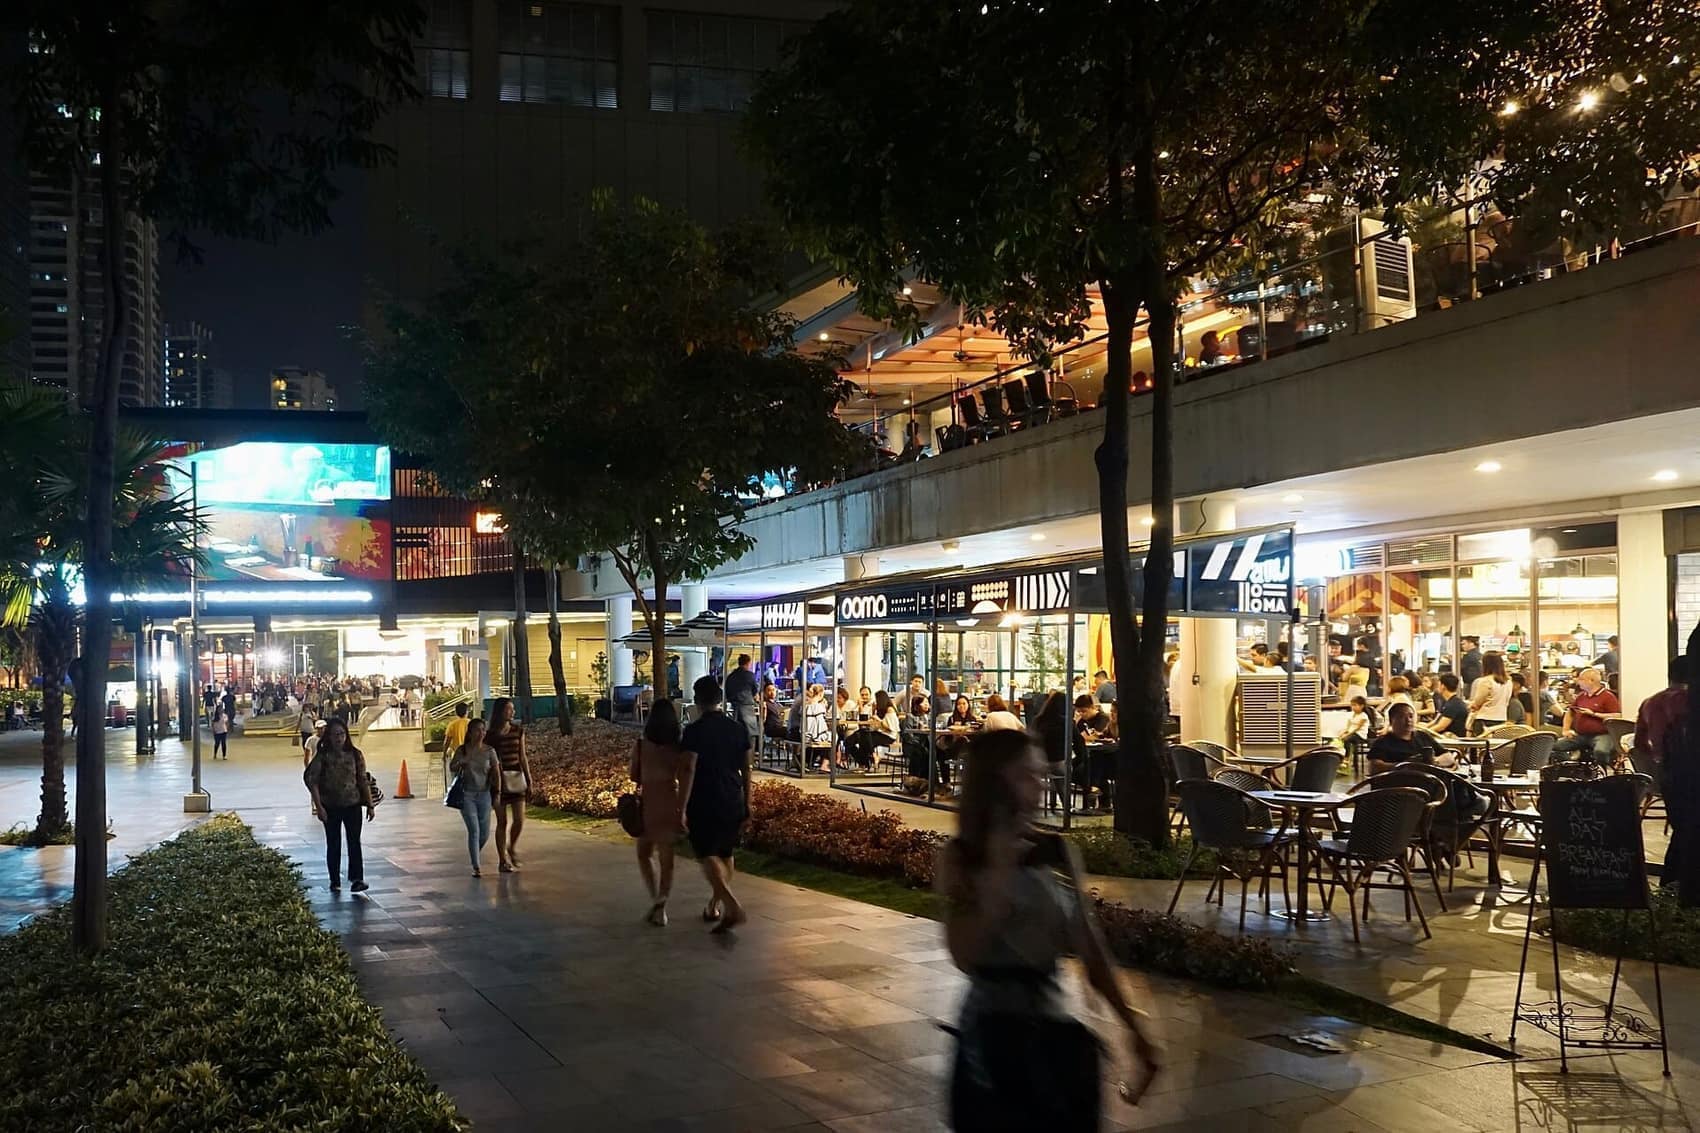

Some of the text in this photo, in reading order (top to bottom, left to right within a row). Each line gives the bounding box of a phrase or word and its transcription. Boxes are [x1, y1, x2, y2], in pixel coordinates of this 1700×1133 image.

[1568, 807, 1607, 824] ALL
[1569, 823, 1607, 845] DAY
[1558, 843, 1635, 868] BREAKFAST
